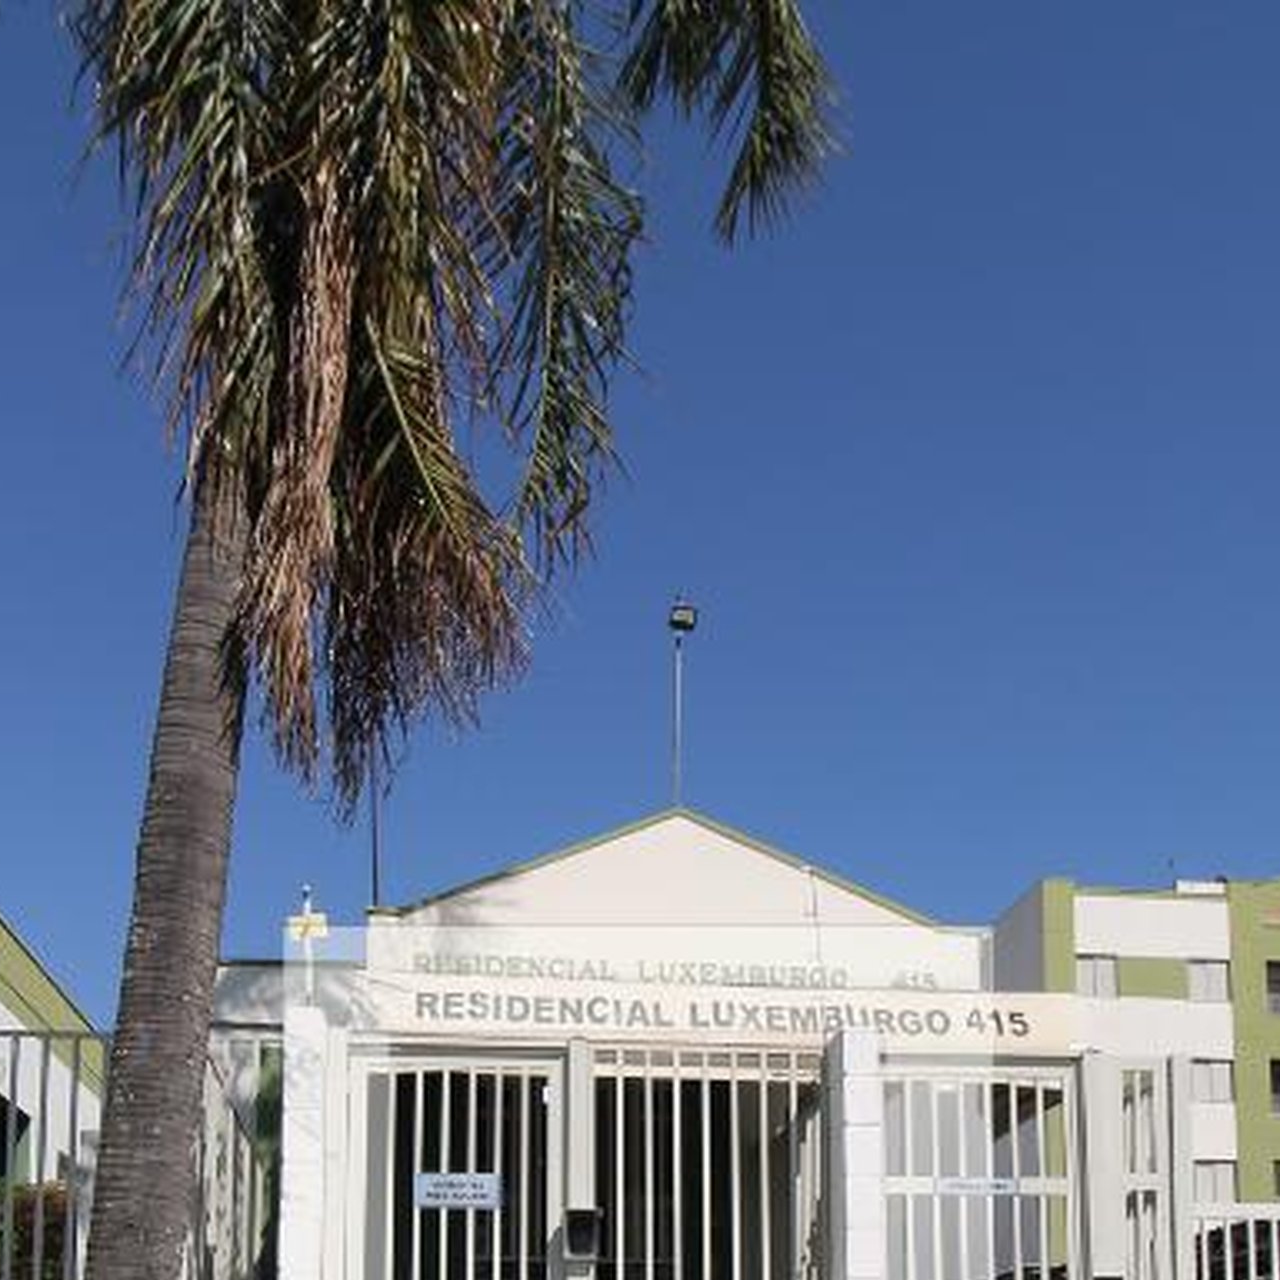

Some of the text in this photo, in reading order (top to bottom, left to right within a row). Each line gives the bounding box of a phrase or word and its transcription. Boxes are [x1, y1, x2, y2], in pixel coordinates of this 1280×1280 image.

[415, 992, 1030, 1037] RESIDENCIAL LUXEMBURGO 415
